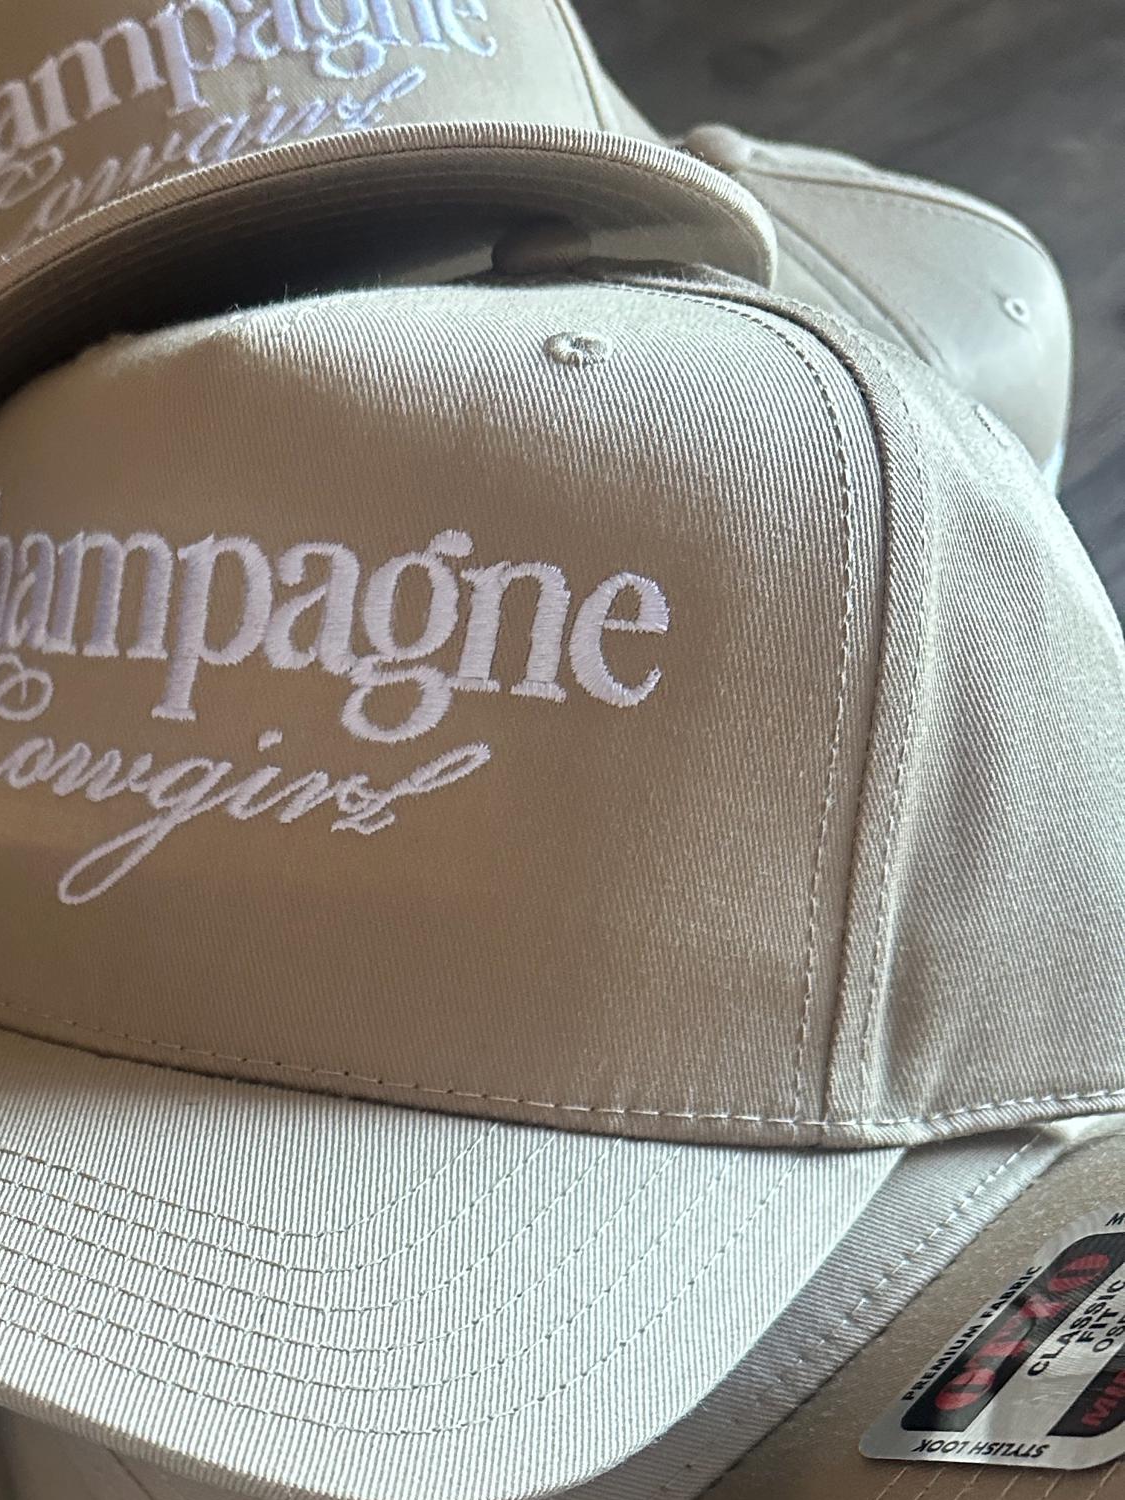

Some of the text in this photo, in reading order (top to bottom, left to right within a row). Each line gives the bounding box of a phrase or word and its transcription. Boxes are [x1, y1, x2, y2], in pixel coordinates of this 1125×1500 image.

[901, 1266, 1042, 1401] PREMIUM FABRIC
[1027, 1280, 1125, 1376] CLASSIC
[1076, 1308, 1119, 1343] FIT
[911, 1439, 1050, 1458] STYLISH LOOK
